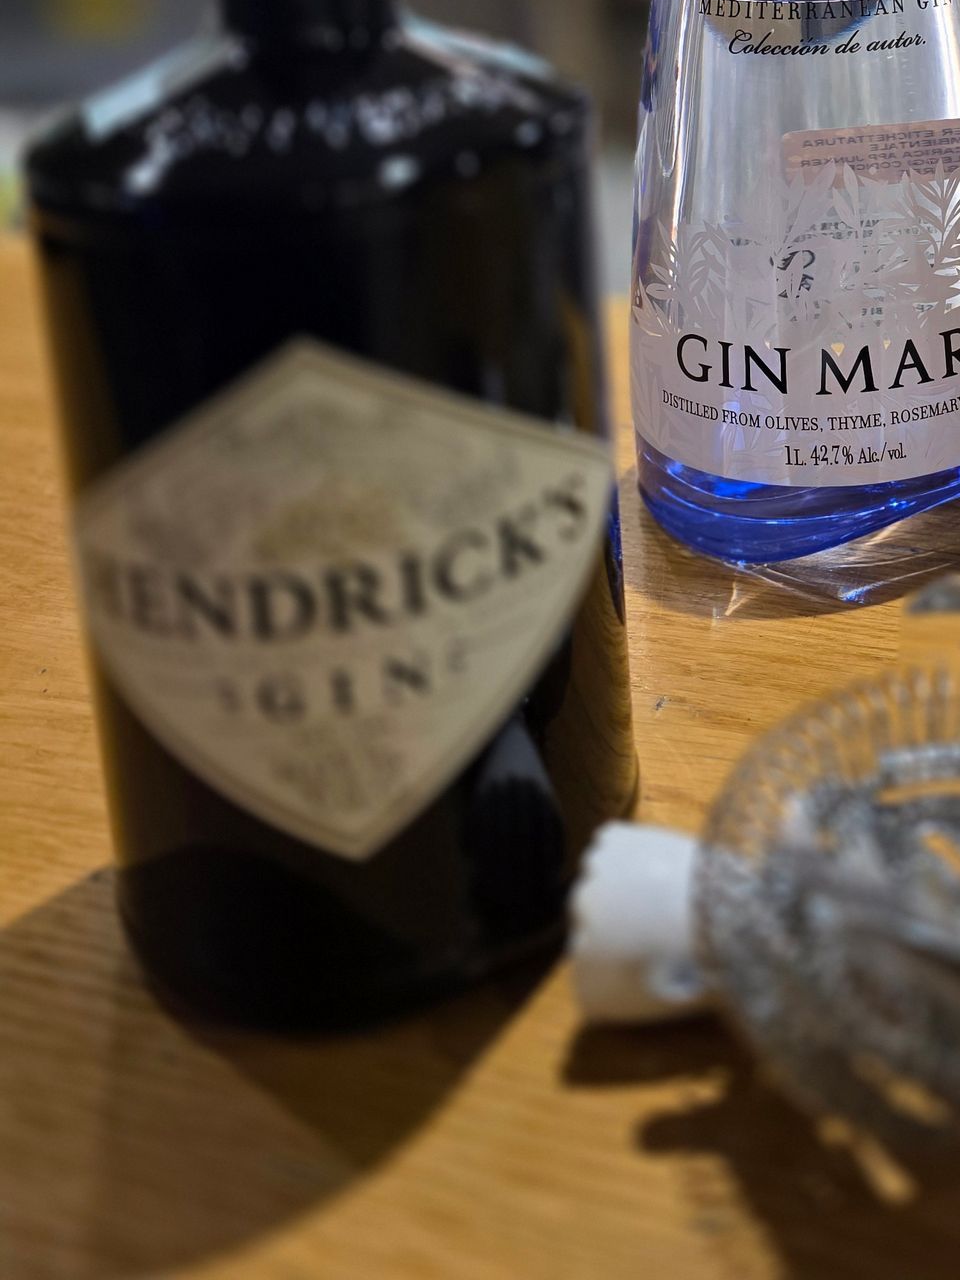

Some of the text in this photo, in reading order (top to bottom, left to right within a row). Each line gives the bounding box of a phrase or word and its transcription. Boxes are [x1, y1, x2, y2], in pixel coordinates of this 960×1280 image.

[728, 29, 926, 57] Colección de autor.
[676, 333, 791, 395] GIN
[662, 389, 719, 421] DISTILLED
[721, 409, 761, 429] FROM
[765, 415, 824, 433] OLIVES,
[827, 412, 887, 431] THYME,
[810, 444, 854, 466] 42.7%
[857, 442, 907, 465] Alc./vol.
[253, 648, 435, 723] GIN
